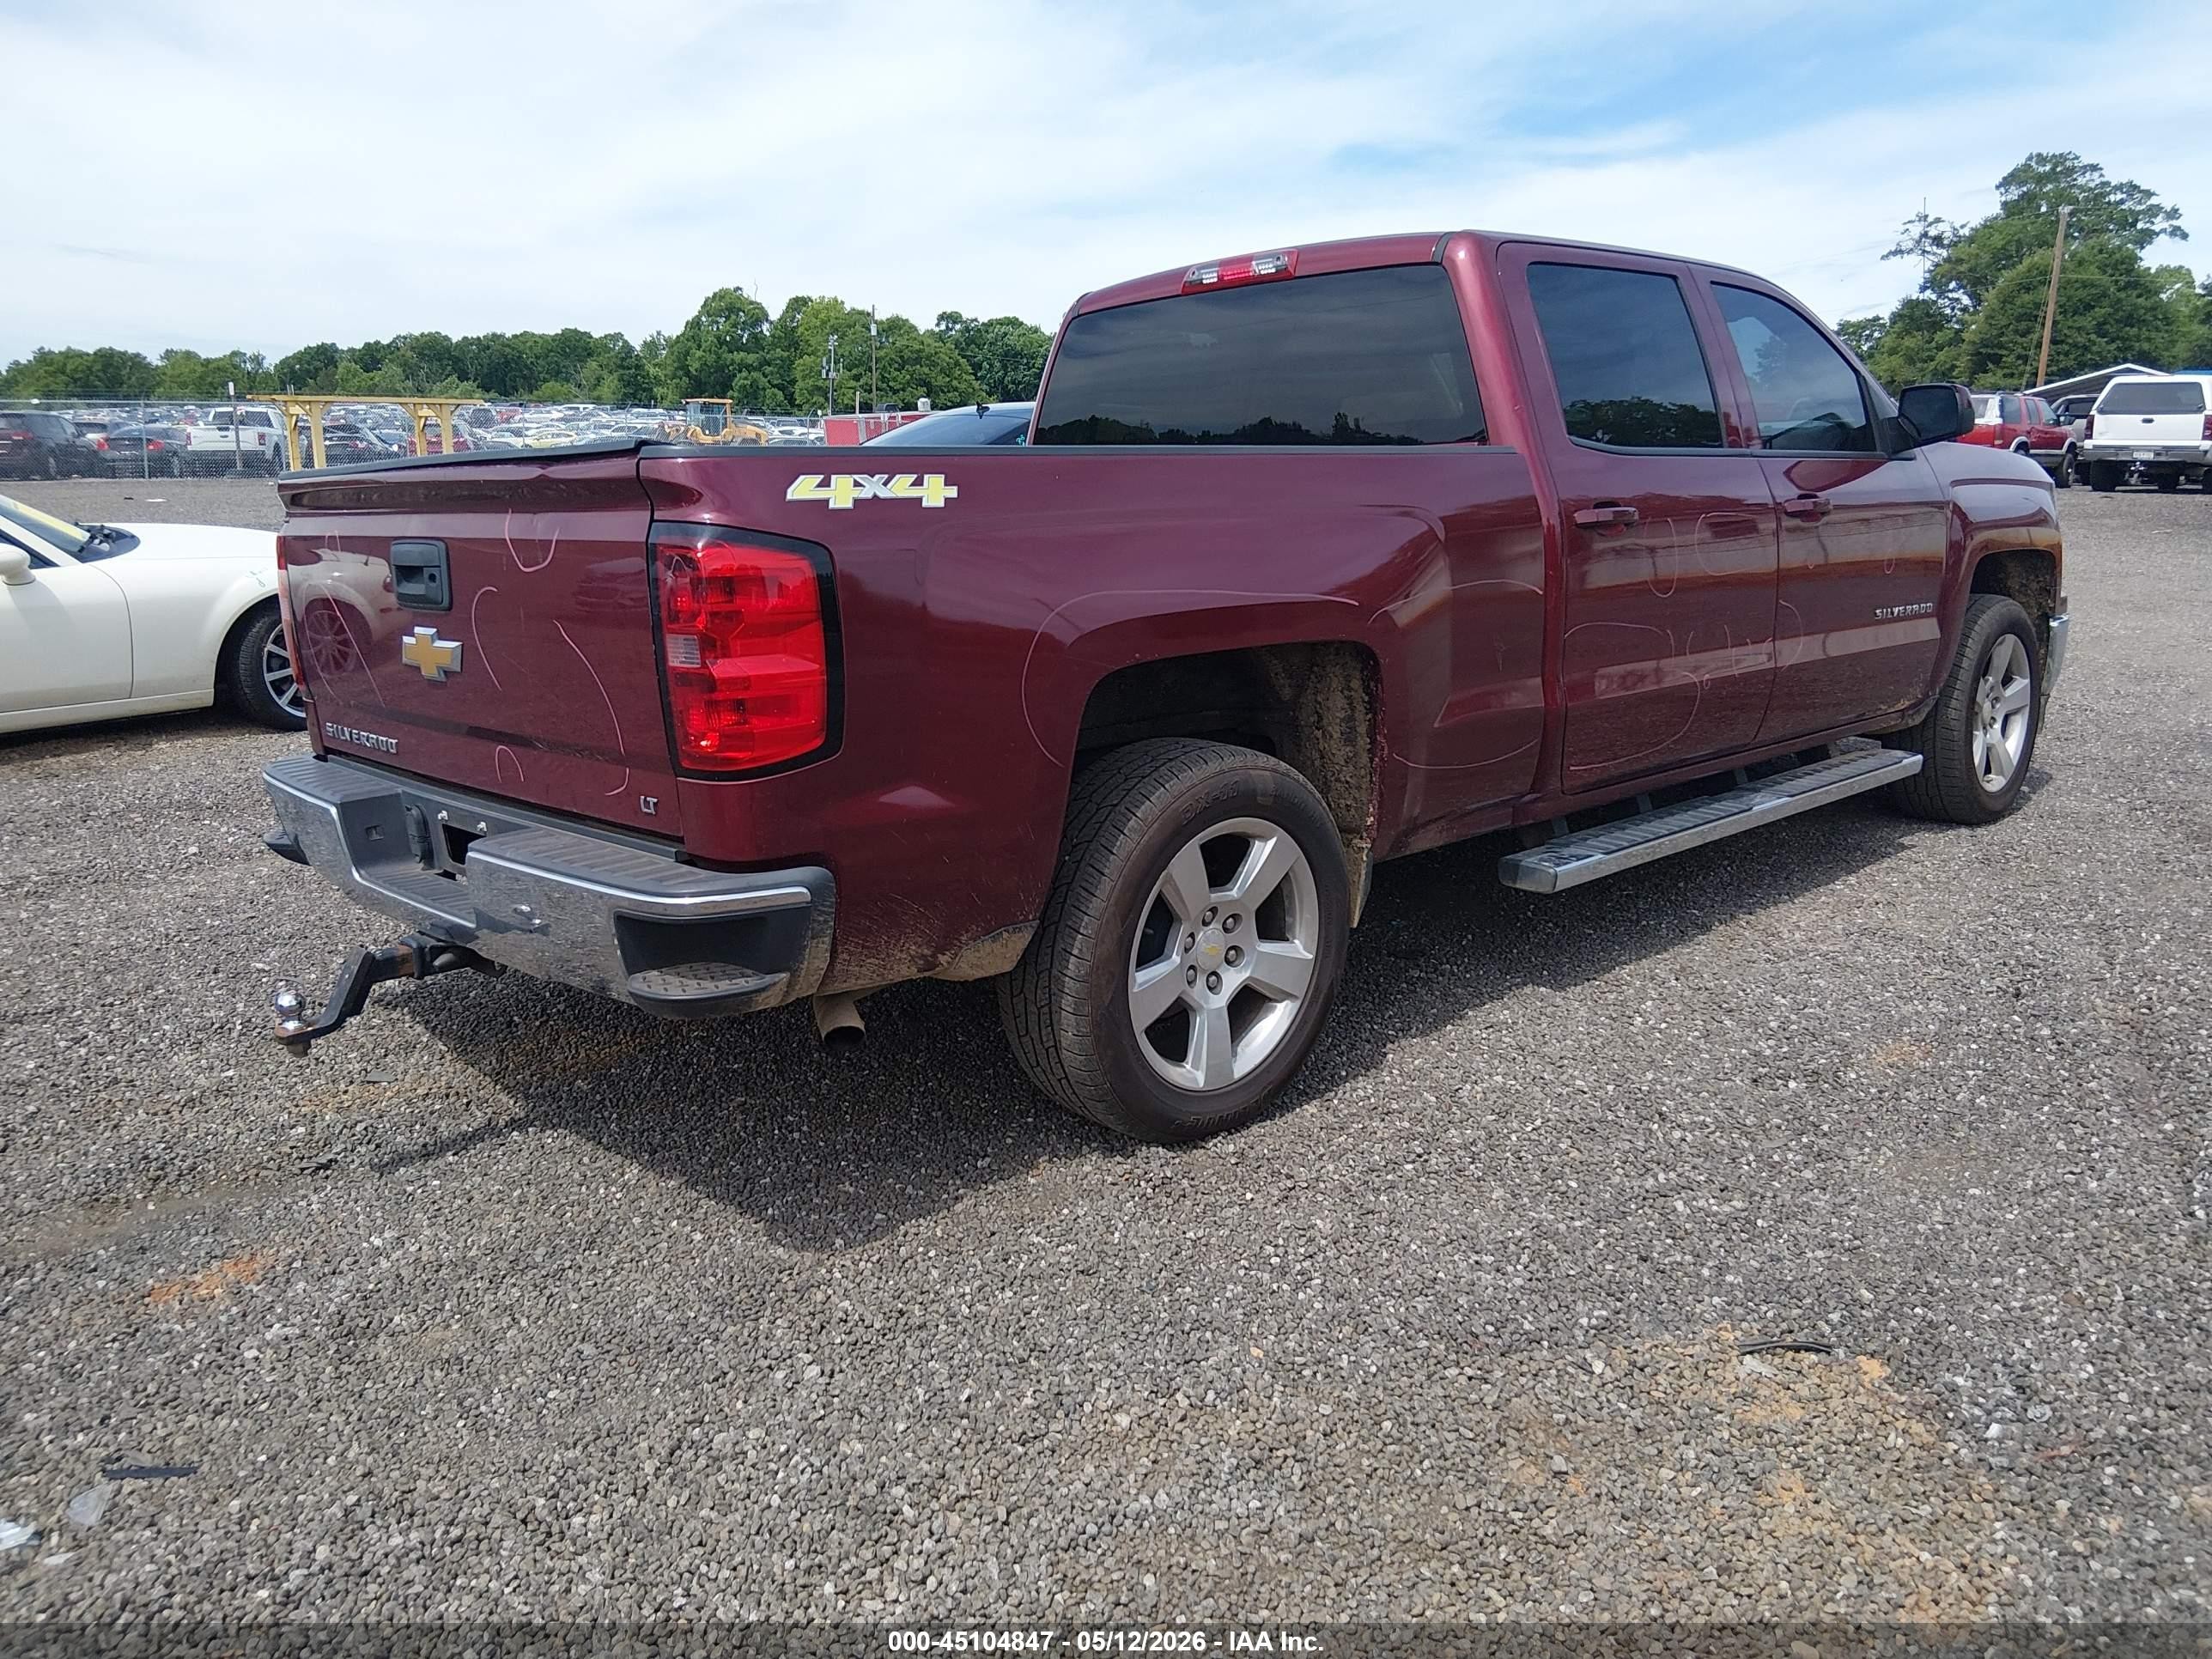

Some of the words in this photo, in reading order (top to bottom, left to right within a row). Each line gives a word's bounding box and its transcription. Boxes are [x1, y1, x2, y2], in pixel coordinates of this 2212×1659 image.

[1875, 602, 1933, 620] SILVERADO
[325, 722, 398, 754] SILVERADO
[640, 795, 659, 815] LT
